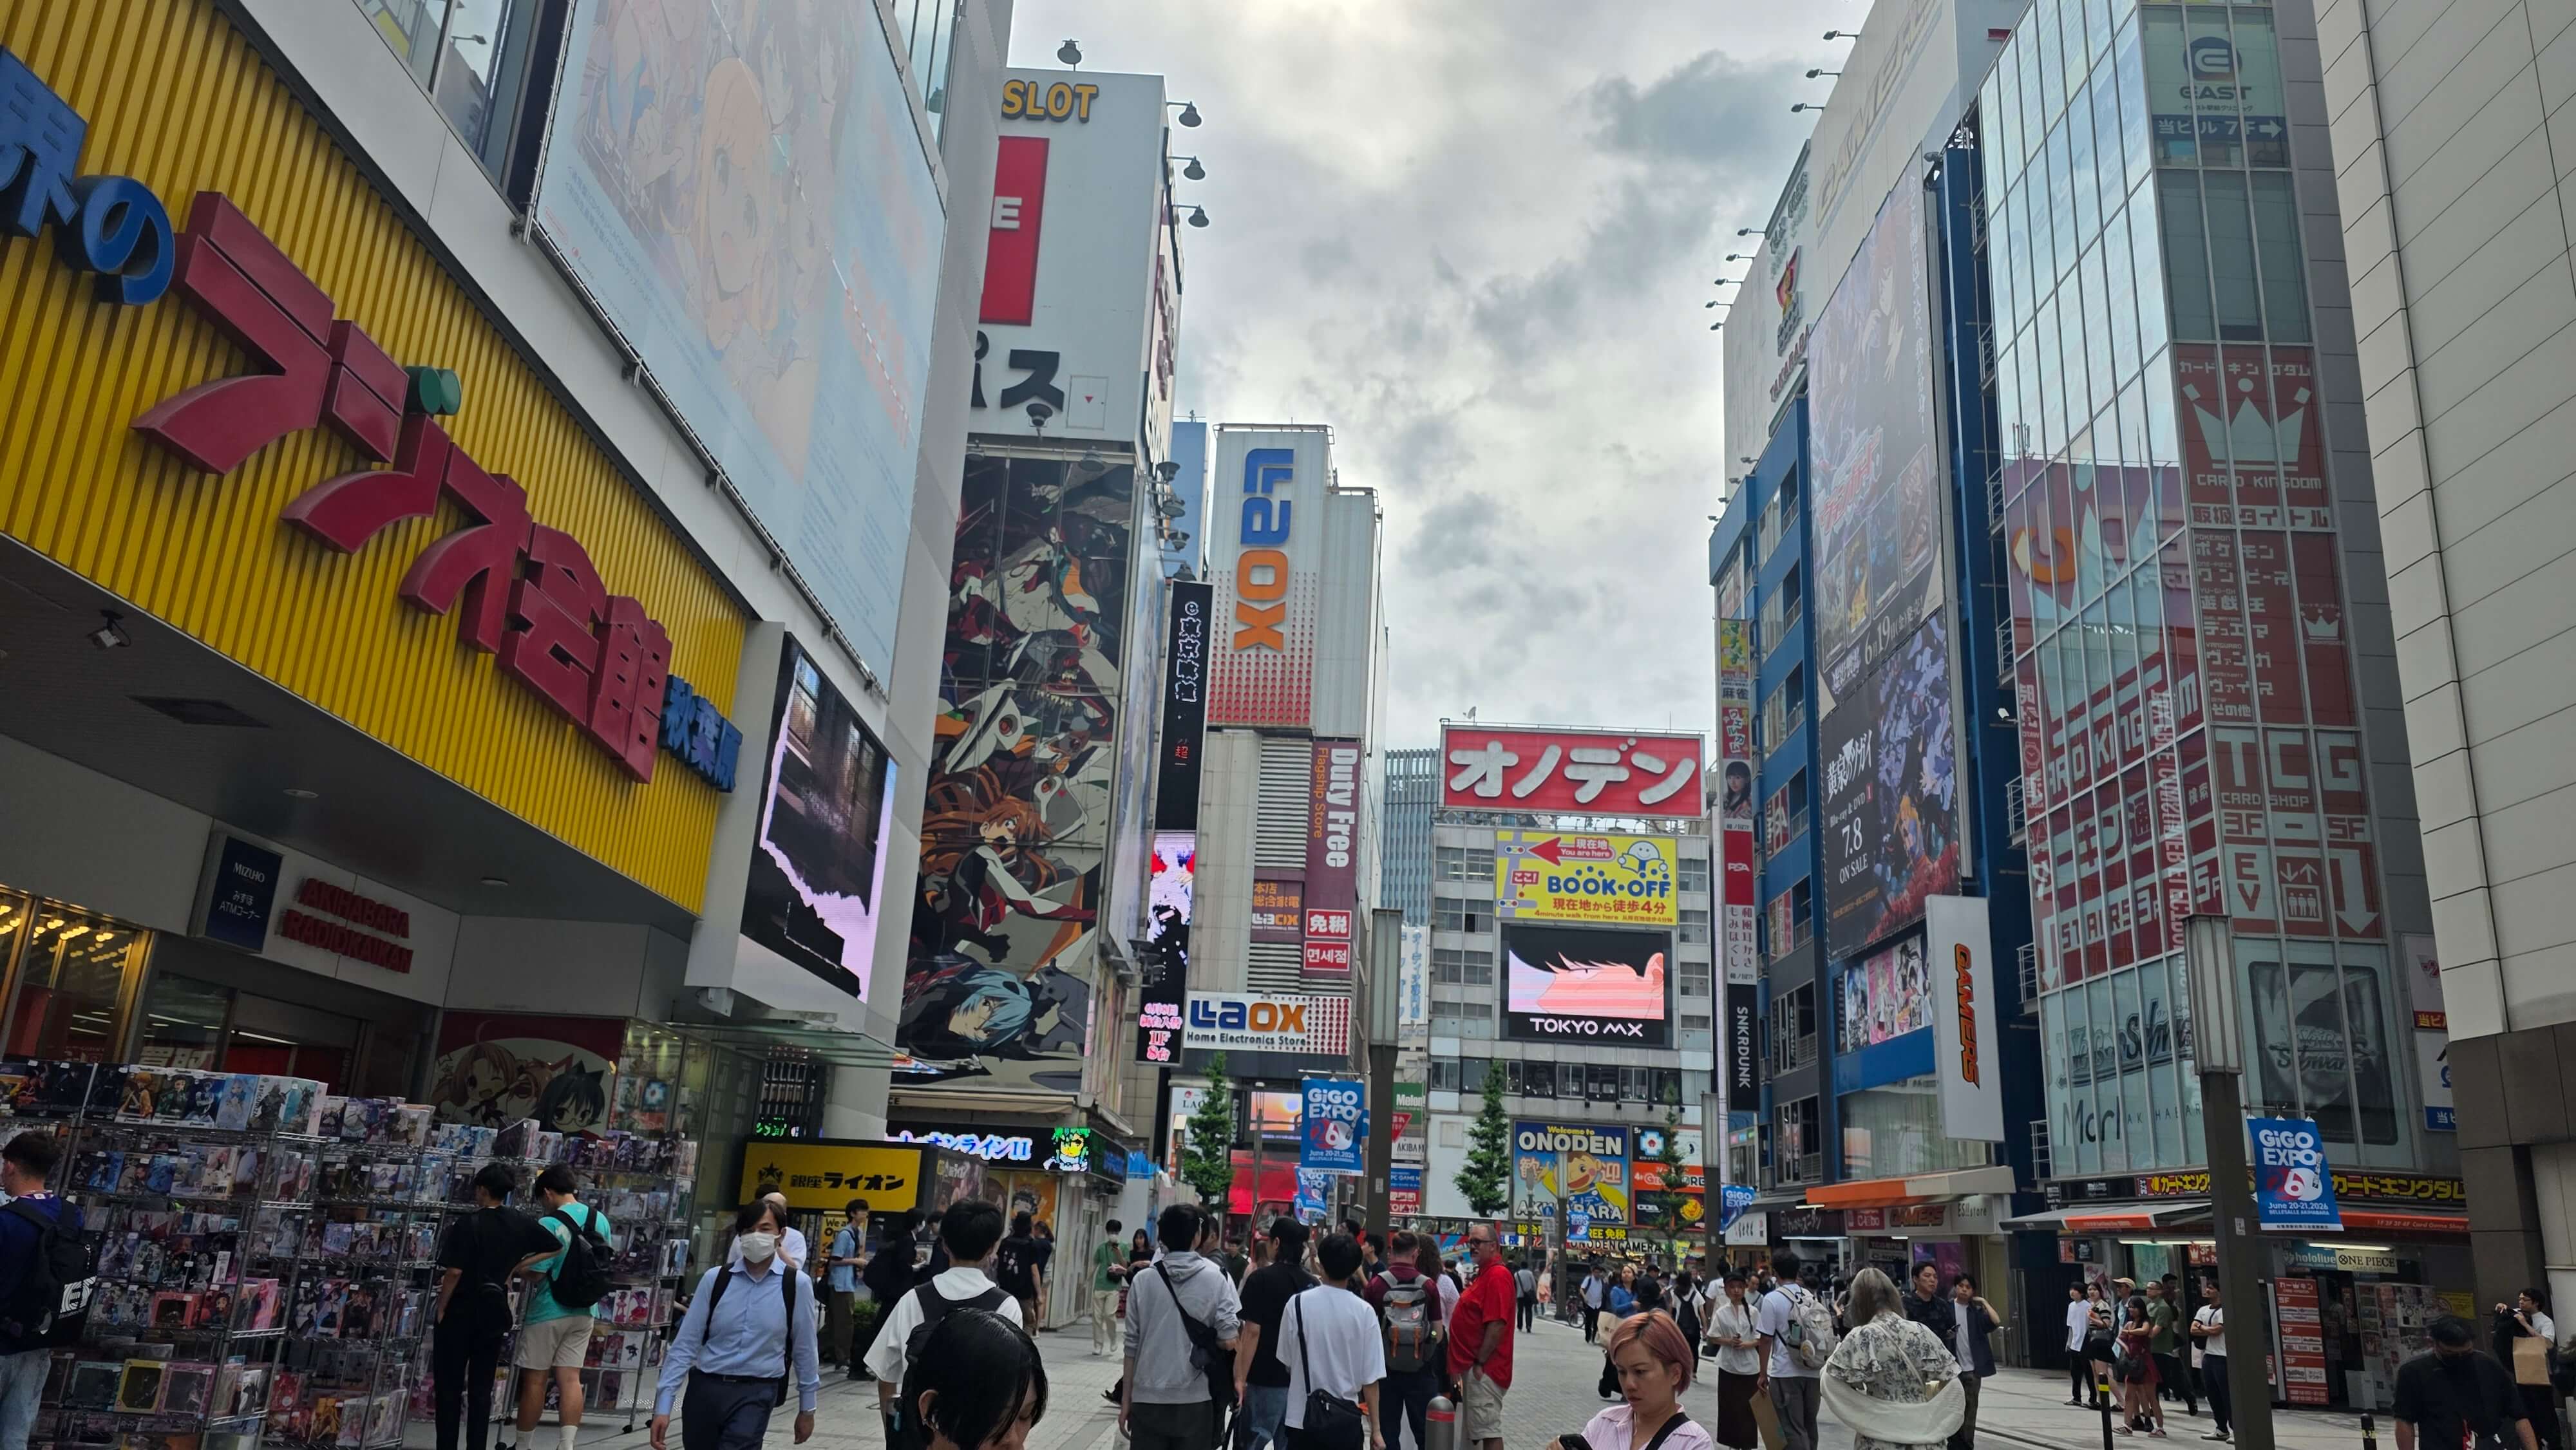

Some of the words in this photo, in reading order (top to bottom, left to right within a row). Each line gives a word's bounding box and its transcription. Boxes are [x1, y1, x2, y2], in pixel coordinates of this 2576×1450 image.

[1001, 80, 1097, 122] SLOT
[2200, 596, 2266, 613] 遊戯王
[2215, 729, 2361, 792] TCG
[1313, 747, 1328, 798] Flagship
[1327, 748, 1358, 806] Duty
[1449, 737, 1696, 805] オノデン
[1853, 792, 1866, 810] DVD
[2222, 793, 2261, 805] CARD
[2269, 795, 2309, 807] SHOP
[1313, 804, 1327, 838] Store
[1326, 811, 1356, 868] Free
[1576, 839, 1607, 850] 現在地
[1842, 816, 1863, 859] 7.8
[1561, 848, 1576, 856] You
[1591, 849, 1610, 858] here
[233, 862, 265, 883] MIZUHO
[1840, 864, 1850, 885] ON
[1851, 852, 1868, 878] SALE
[1254, 882, 1278, 894] 本店
[232, 890, 254, 906] みずほ
[1253, 895, 1299, 907] 総合家電
[1553, 898, 1667, 914] 現在地から徒歩4分
[218, 901, 261, 919] ATMコーナー
[297, 878, 410, 938] AKIHABARA
[1309, 914, 1347, 934] 免税
[1307, 949, 1347, 965] 면세점
[1955, 943, 1980, 1089] GAMERS
[1530, 1017, 1598, 1035] TOKYO
[1604, 1022, 1643, 1037] MX
[1187, 1032, 1216, 1044] Home
[1220, 1033, 1274, 1046] Electronics
[1278, 1035, 1306, 1046] Store
[1737, 1006, 1750, 1088] SNKRDUNK
[1309, 1103, 1357, 1121] EXPO
[1547, 1125, 1584, 1135] Welcome
[2259, 1129, 2314, 1149] GiGO
[1519, 1131, 1622, 1155] ONODEN
[2262, 1147, 2318, 1166] EXPO
[790, 1172, 904, 1191] 銀座ライオン
[2161, 1173, 2210, 1194] カードキング
[2289, 1202, 2329, 1210] 20-21.2026
[1889, 1206, 1945, 1227] GAMERS
[1605, 1229, 1627, 1240] 免税
[2365, 1256, 2395, 1268] PIECE
